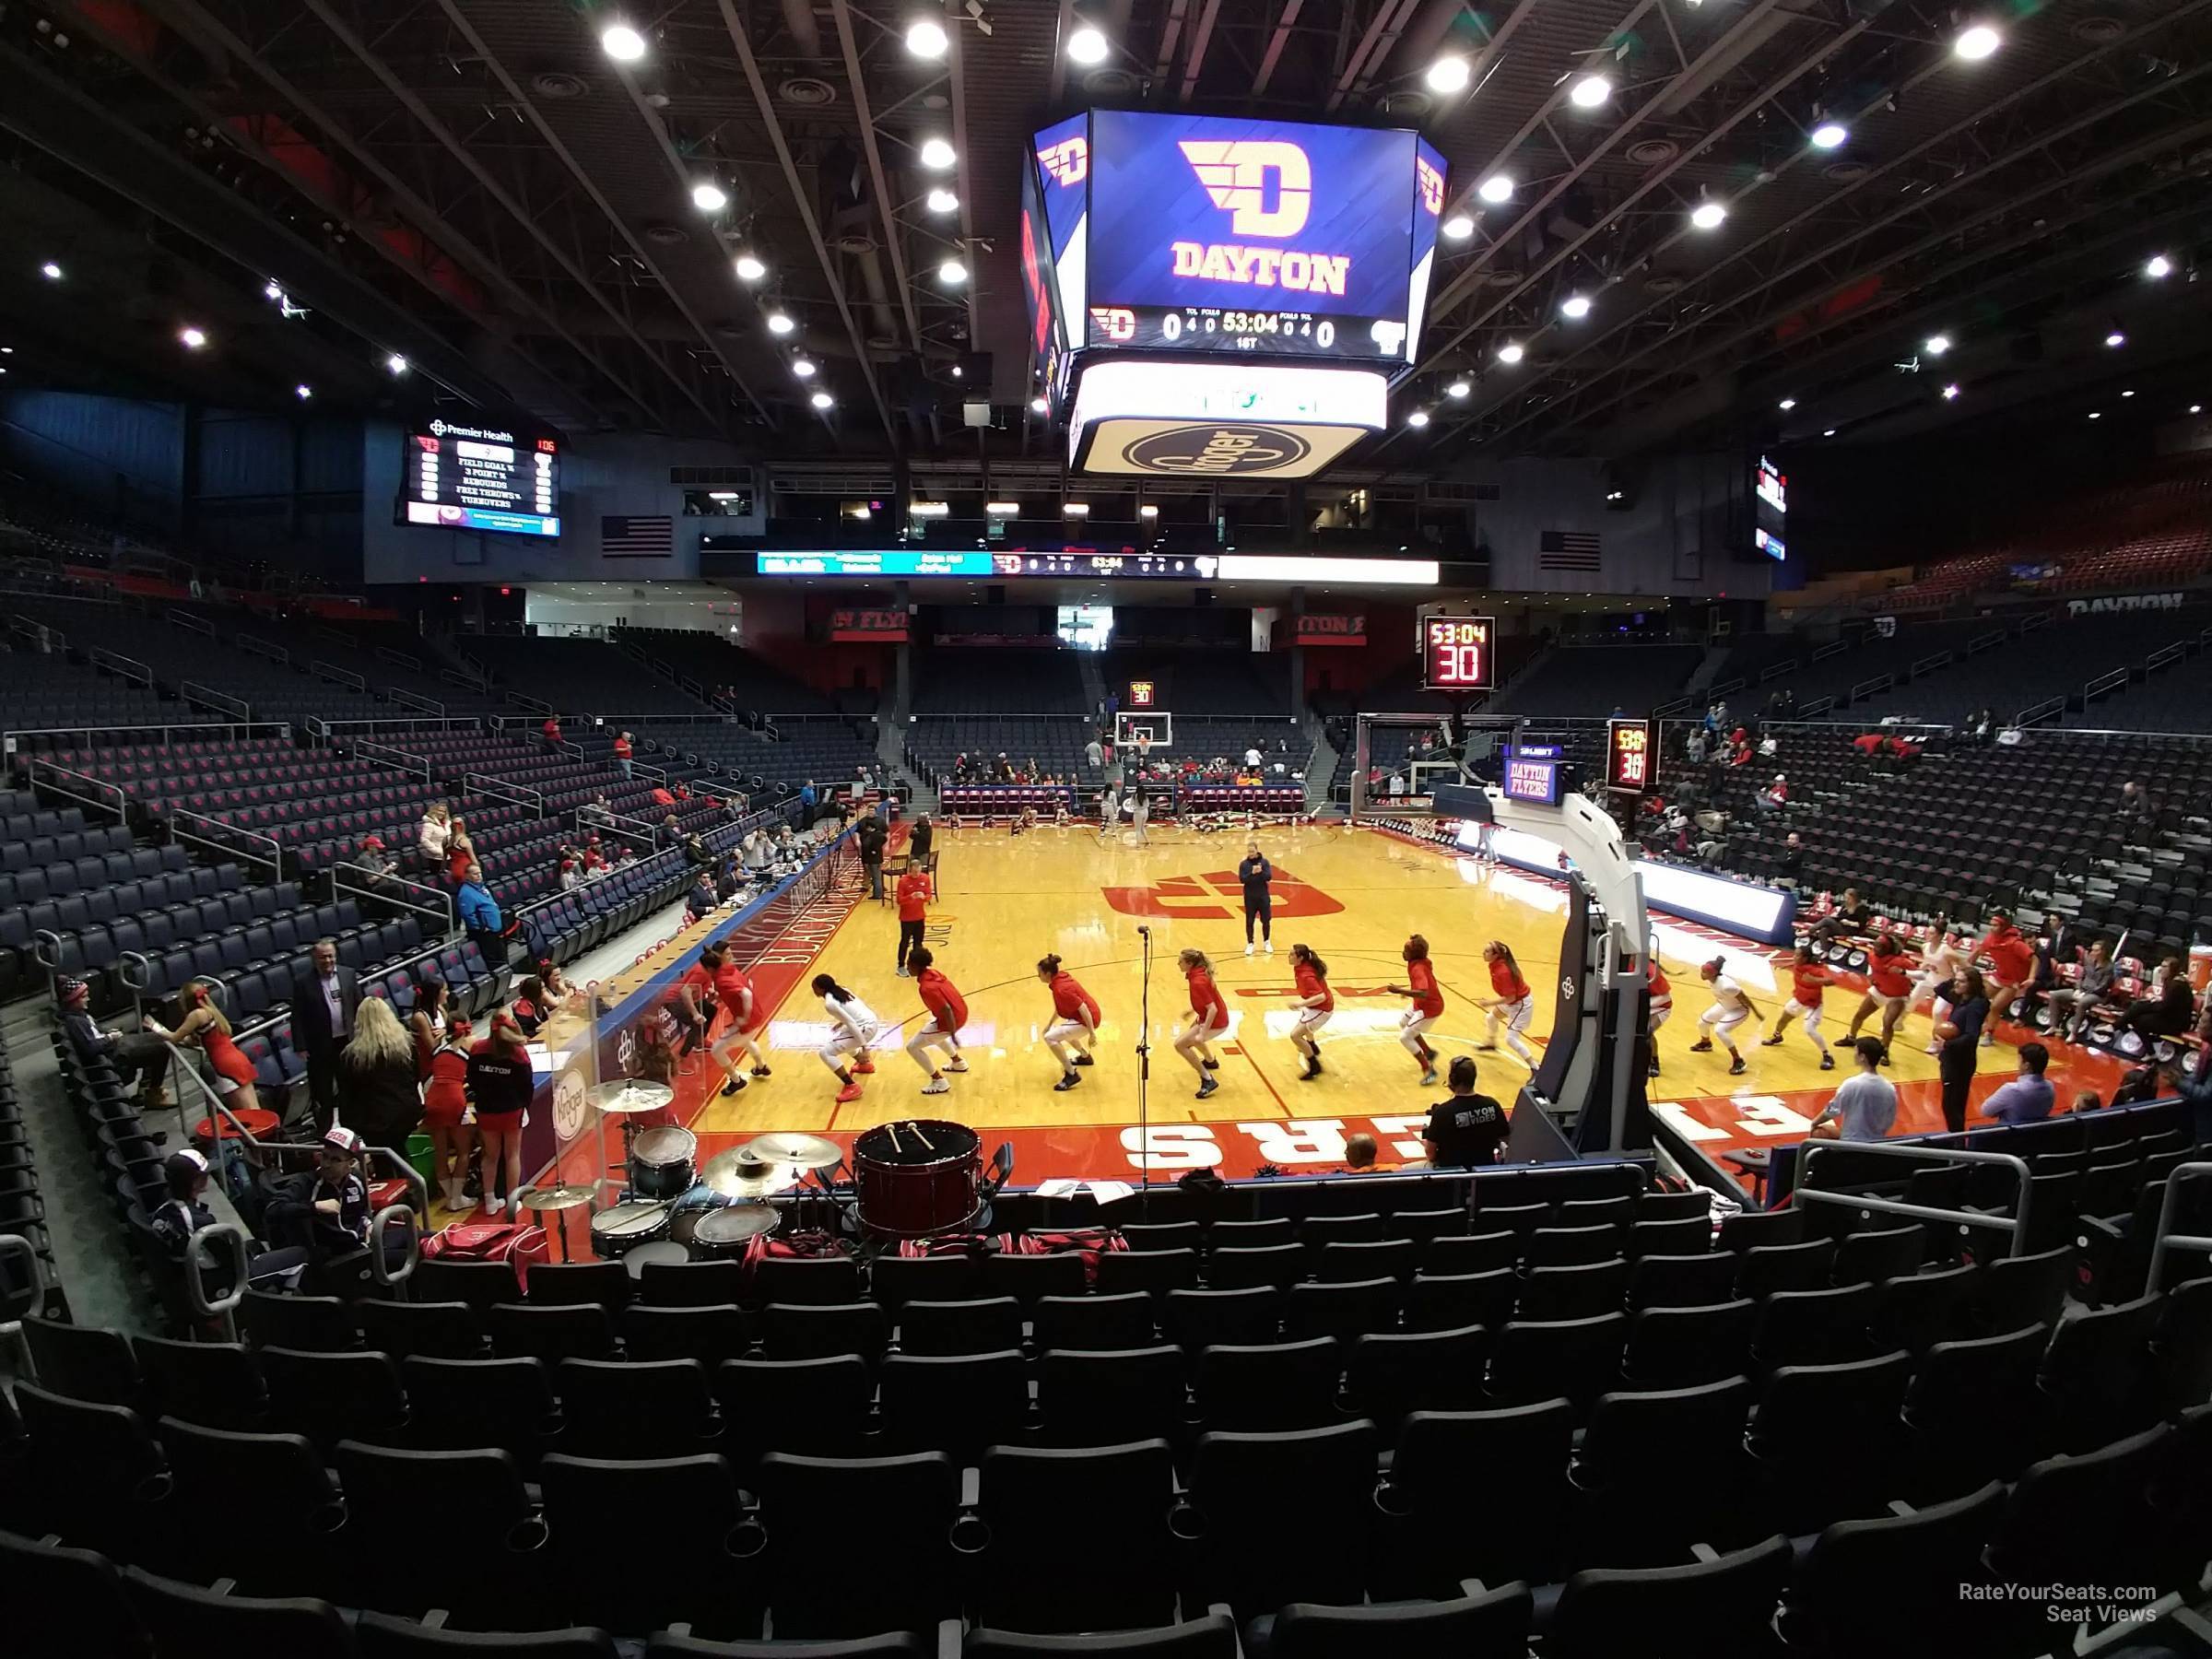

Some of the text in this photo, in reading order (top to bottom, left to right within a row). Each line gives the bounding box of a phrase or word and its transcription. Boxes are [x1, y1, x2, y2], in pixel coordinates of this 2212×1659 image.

[1171, 241, 1349, 295] DAYTON
[1162, 313, 1182, 340] 0
[1186, 318, 1196, 332] 4
[1206, 318, 1216, 332] 0
[1223, 312, 1278, 334] 53:04
[1284, 322, 1294, 335] 0
[1300, 323, 1311, 336] 4
[1317, 322, 1335, 347] 0
[1237, 337, 1257, 348] 1ST
[447, 424, 513, 442] Premier Health
[458, 458, 484, 467] FIELD
[485, 460, 506, 471] GOAL
[473, 469, 499, 478] POINT
[463, 477, 508, 489] REBOUNDS
[456, 485, 478, 496] FREE
[479, 488, 514, 500] THROWS
[1430, 623, 1486, 644] 53:04
[1439, 645, 1478, 681] 30
[1135, 691, 1149, 702] 30
[1510, 763, 1551, 782] DAYTON
[1511, 778, 1549, 797] FLYERS
[557, 1086, 583, 1128] Kroger
[1469, 1106, 1495, 1118] LYON
[1470, 1113, 1497, 1125] VIDEO
